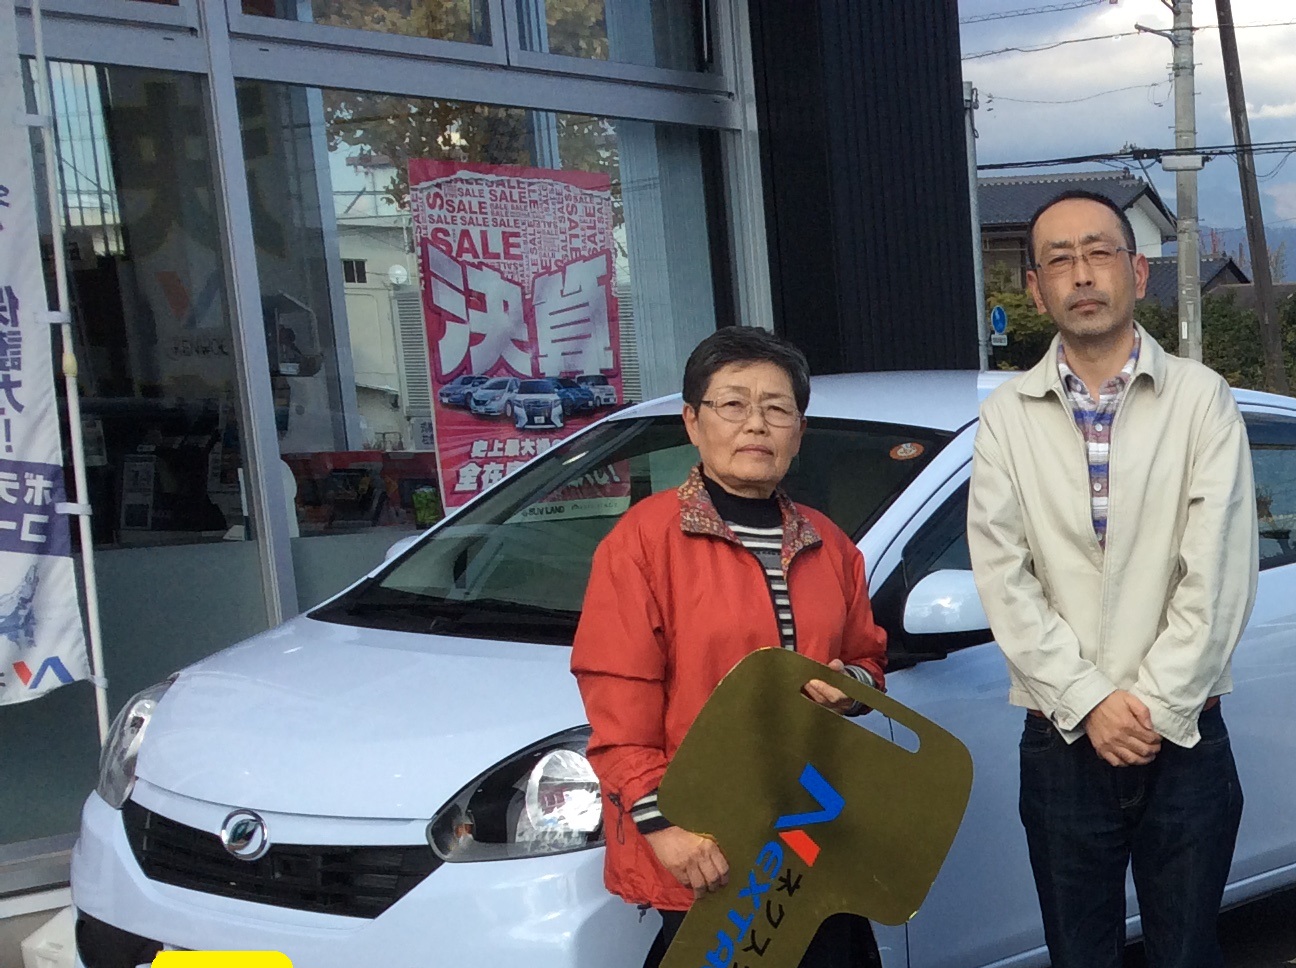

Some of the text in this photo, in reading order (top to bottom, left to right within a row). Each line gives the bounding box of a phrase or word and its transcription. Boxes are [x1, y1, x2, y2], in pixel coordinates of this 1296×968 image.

[458, 188, 528, 203] SALE SALE
[446, 200, 488, 215] SALE
[428, 214, 521, 228] SALE SALE SALE
[431, 227, 524, 260] SALE
[428, 243, 614, 379] 決算
